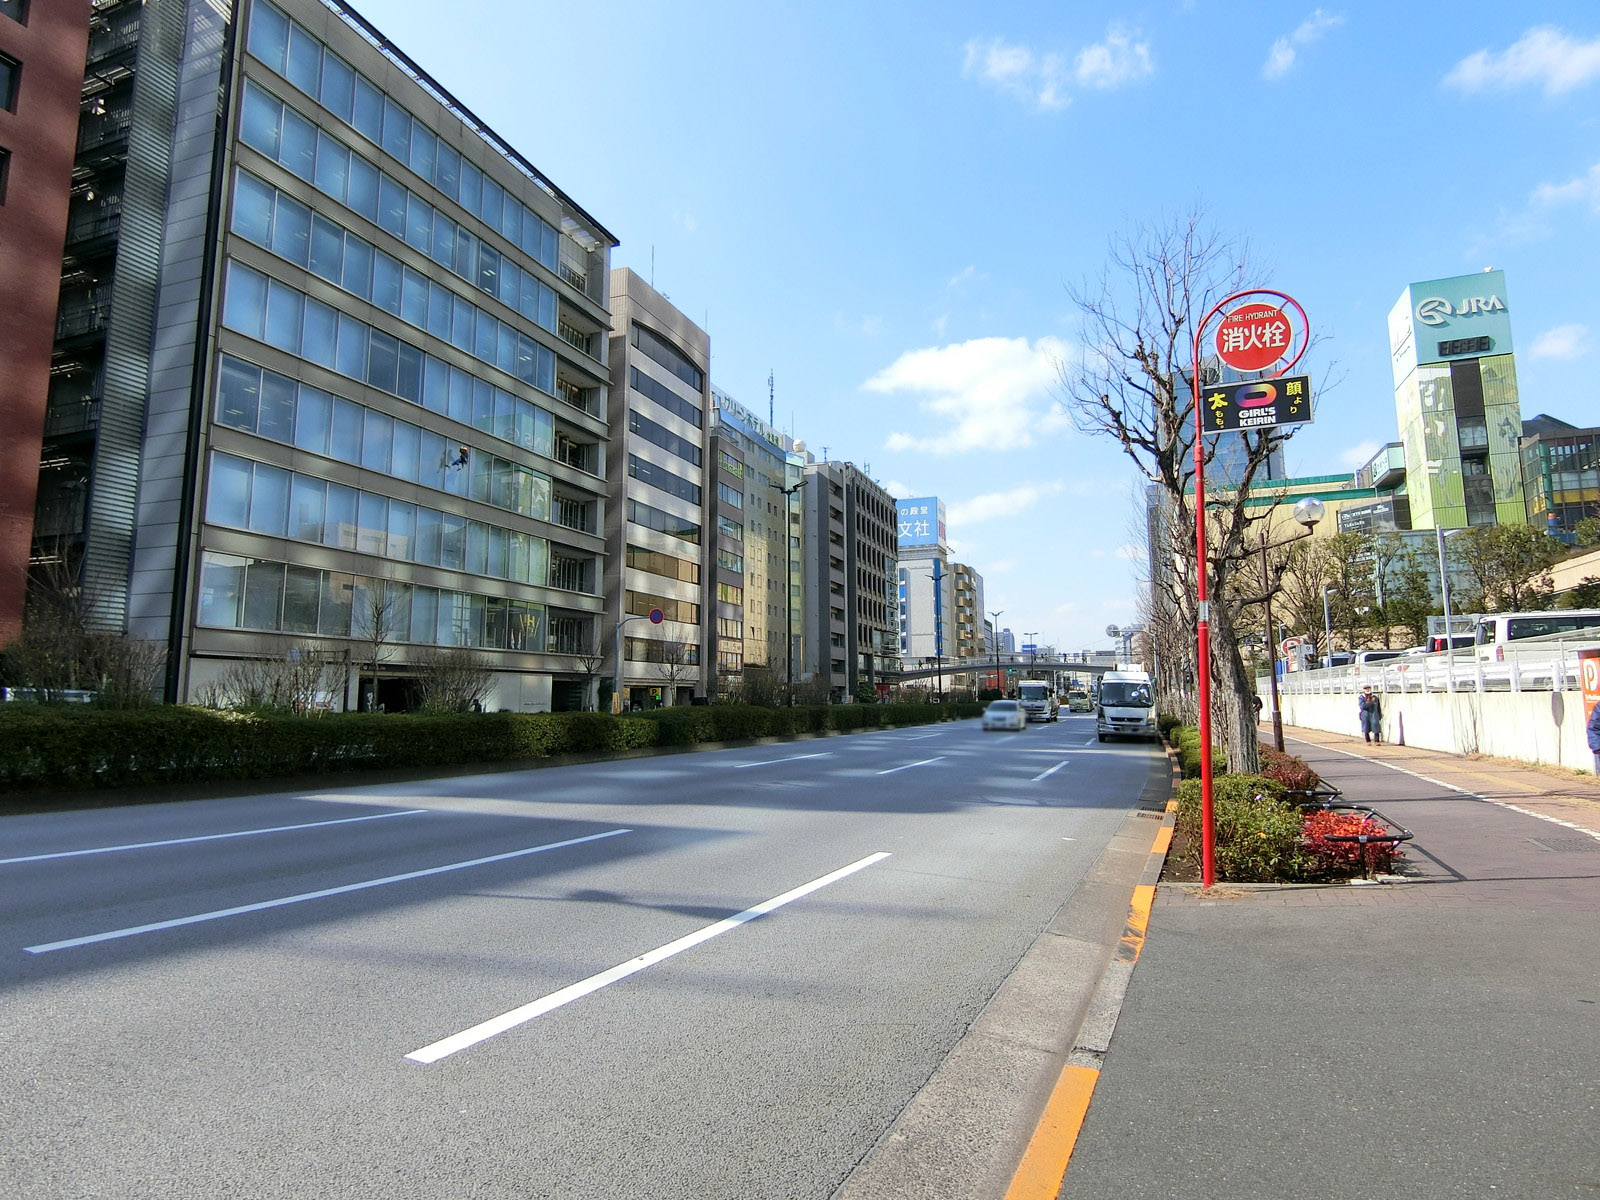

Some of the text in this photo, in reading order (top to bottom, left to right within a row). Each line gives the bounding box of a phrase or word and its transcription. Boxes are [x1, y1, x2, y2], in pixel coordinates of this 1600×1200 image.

[1456, 295, 1504, 315] JRA
[1228, 309, 1278, 323] FIRE HYDRANT
[1222, 320, 1286, 353] 消火栓
[1286, 381, 1302, 414] 顔より
[1238, 406, 1276, 419] GIRL'S
[1239, 415, 1276, 427] KEIRIN
